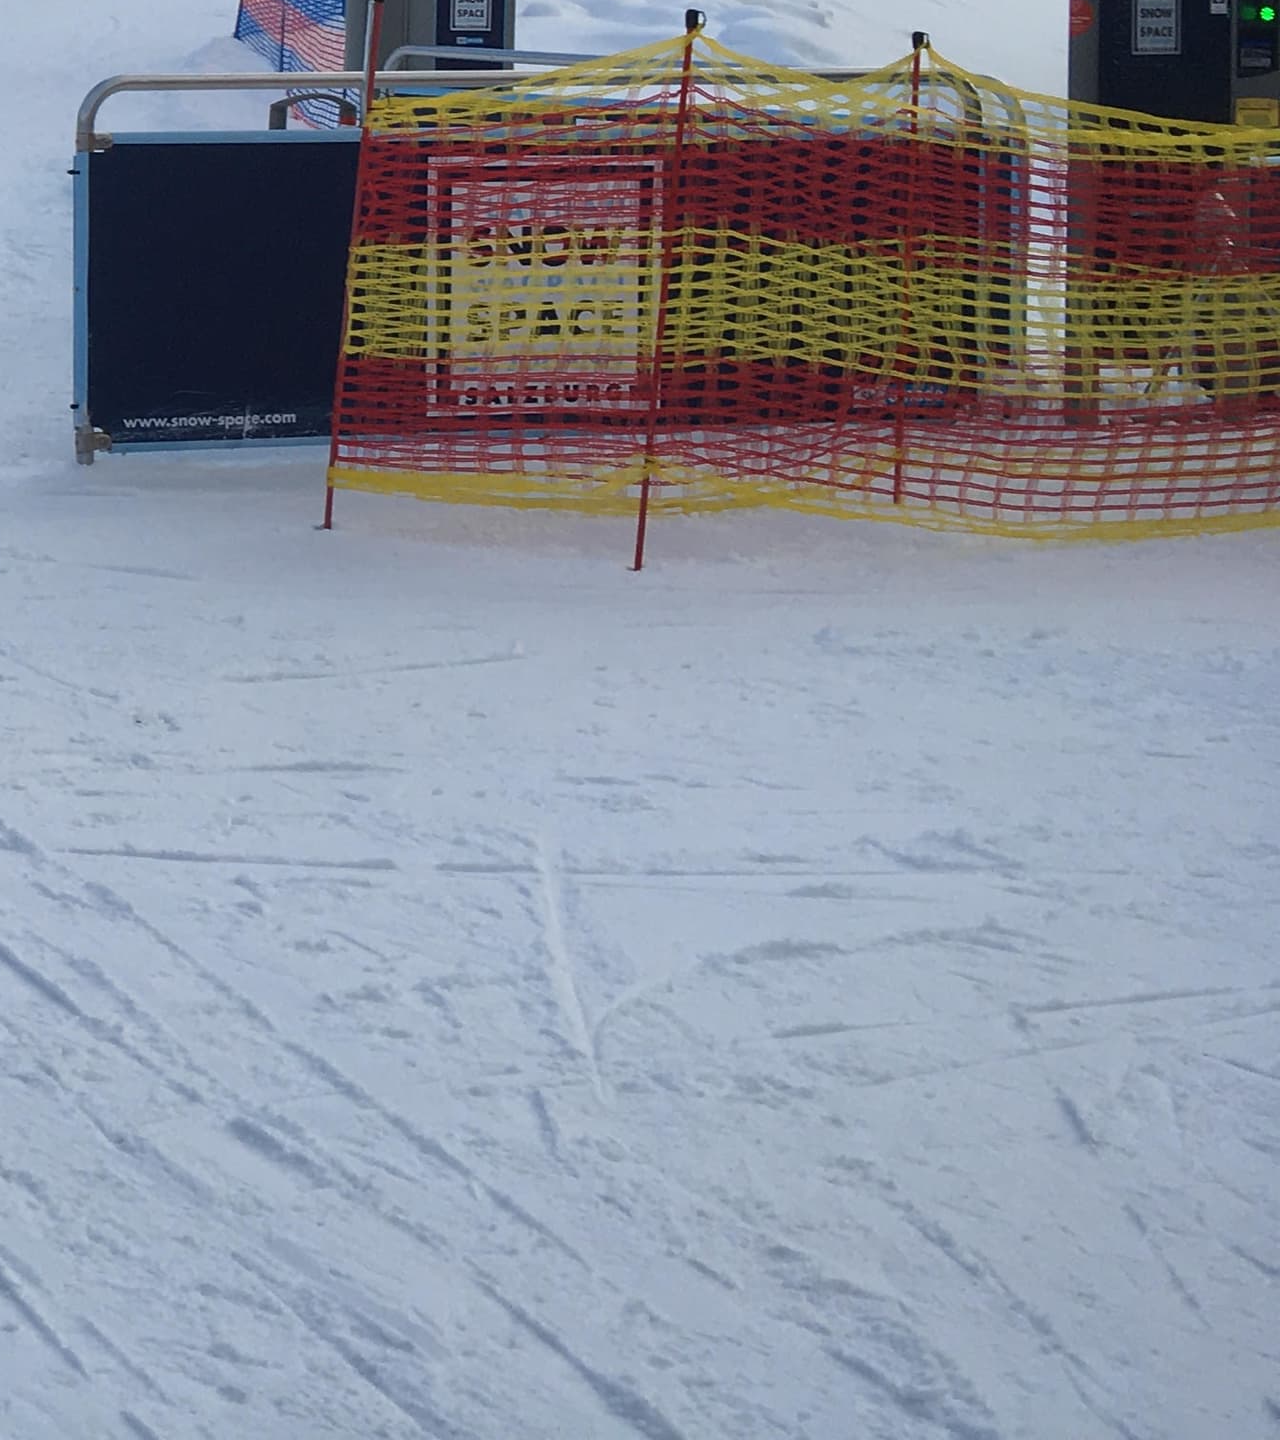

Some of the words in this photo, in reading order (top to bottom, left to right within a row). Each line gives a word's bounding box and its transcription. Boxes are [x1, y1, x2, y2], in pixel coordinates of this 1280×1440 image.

[457, 8, 485, 18] SPACE
[1140, 7, 1173, 19] SNOW
[1140, 26, 1174, 38] SPACE
[123, 412, 297, 429] www.snow-space.com
